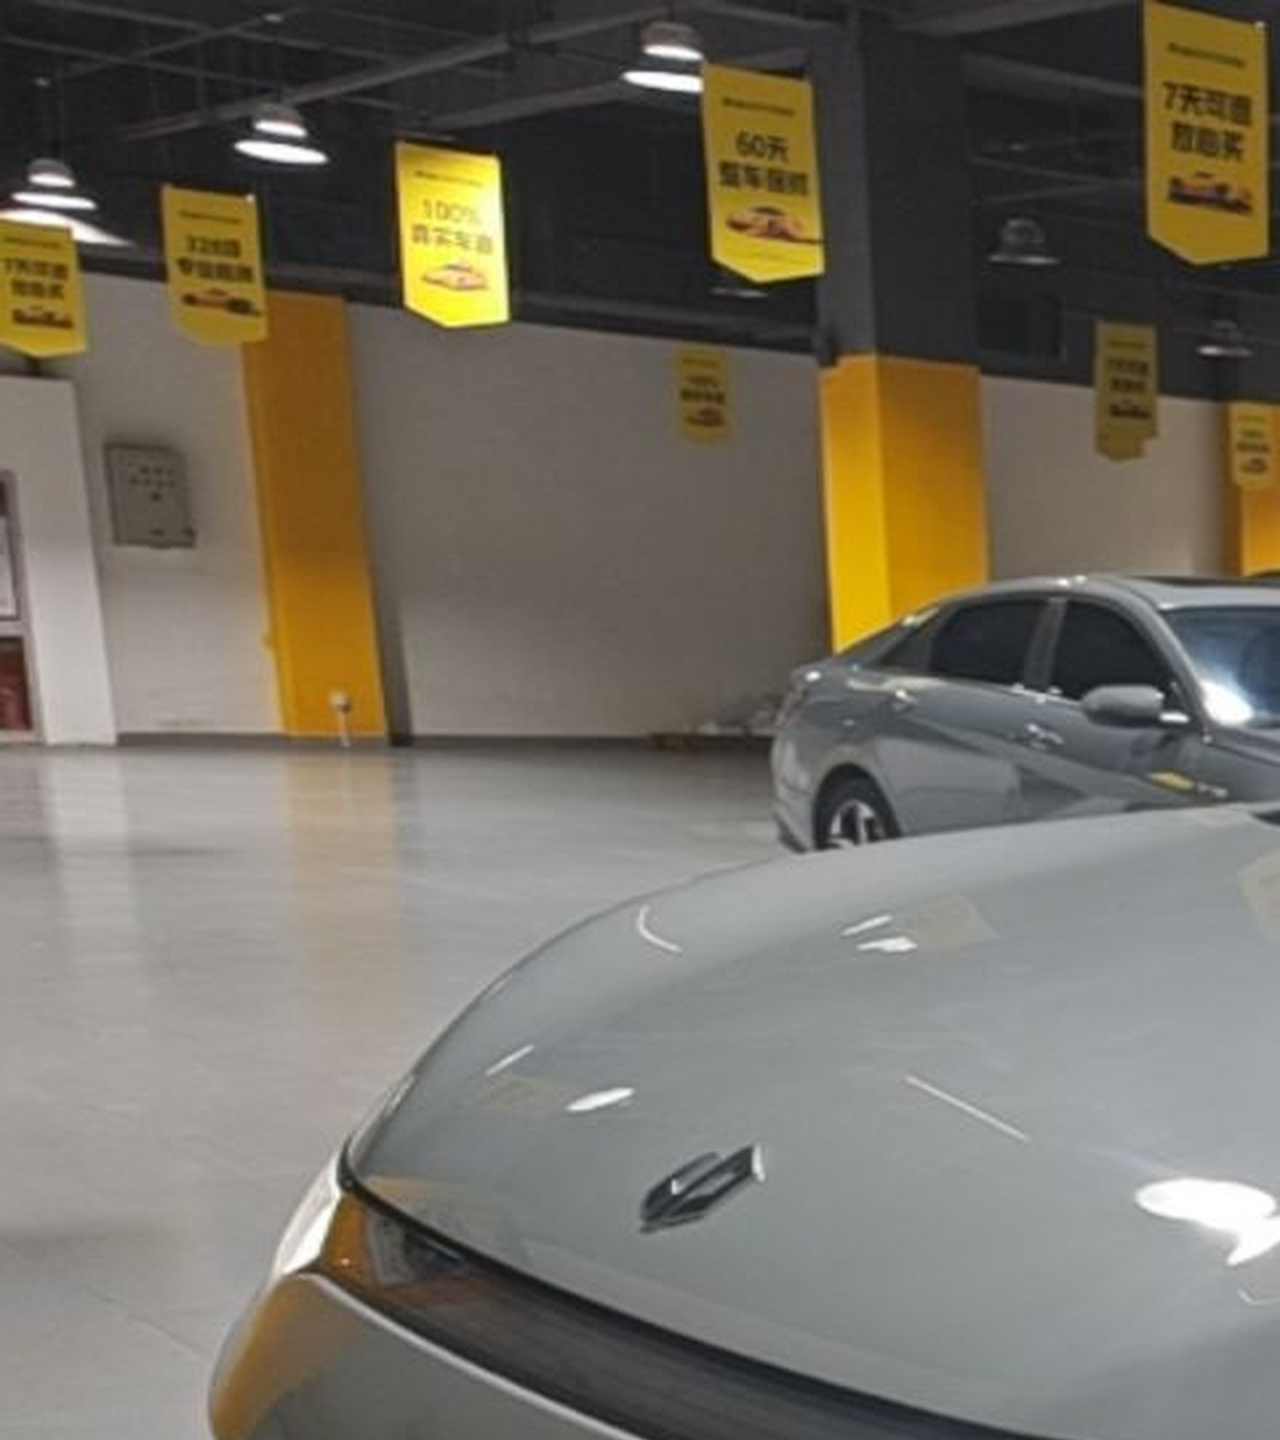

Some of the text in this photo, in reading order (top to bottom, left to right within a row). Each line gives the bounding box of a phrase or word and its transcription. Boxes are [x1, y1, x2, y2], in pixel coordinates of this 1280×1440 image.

[1163, 80, 1252, 127] 7天可退
[735, 130, 789, 163] 60天
